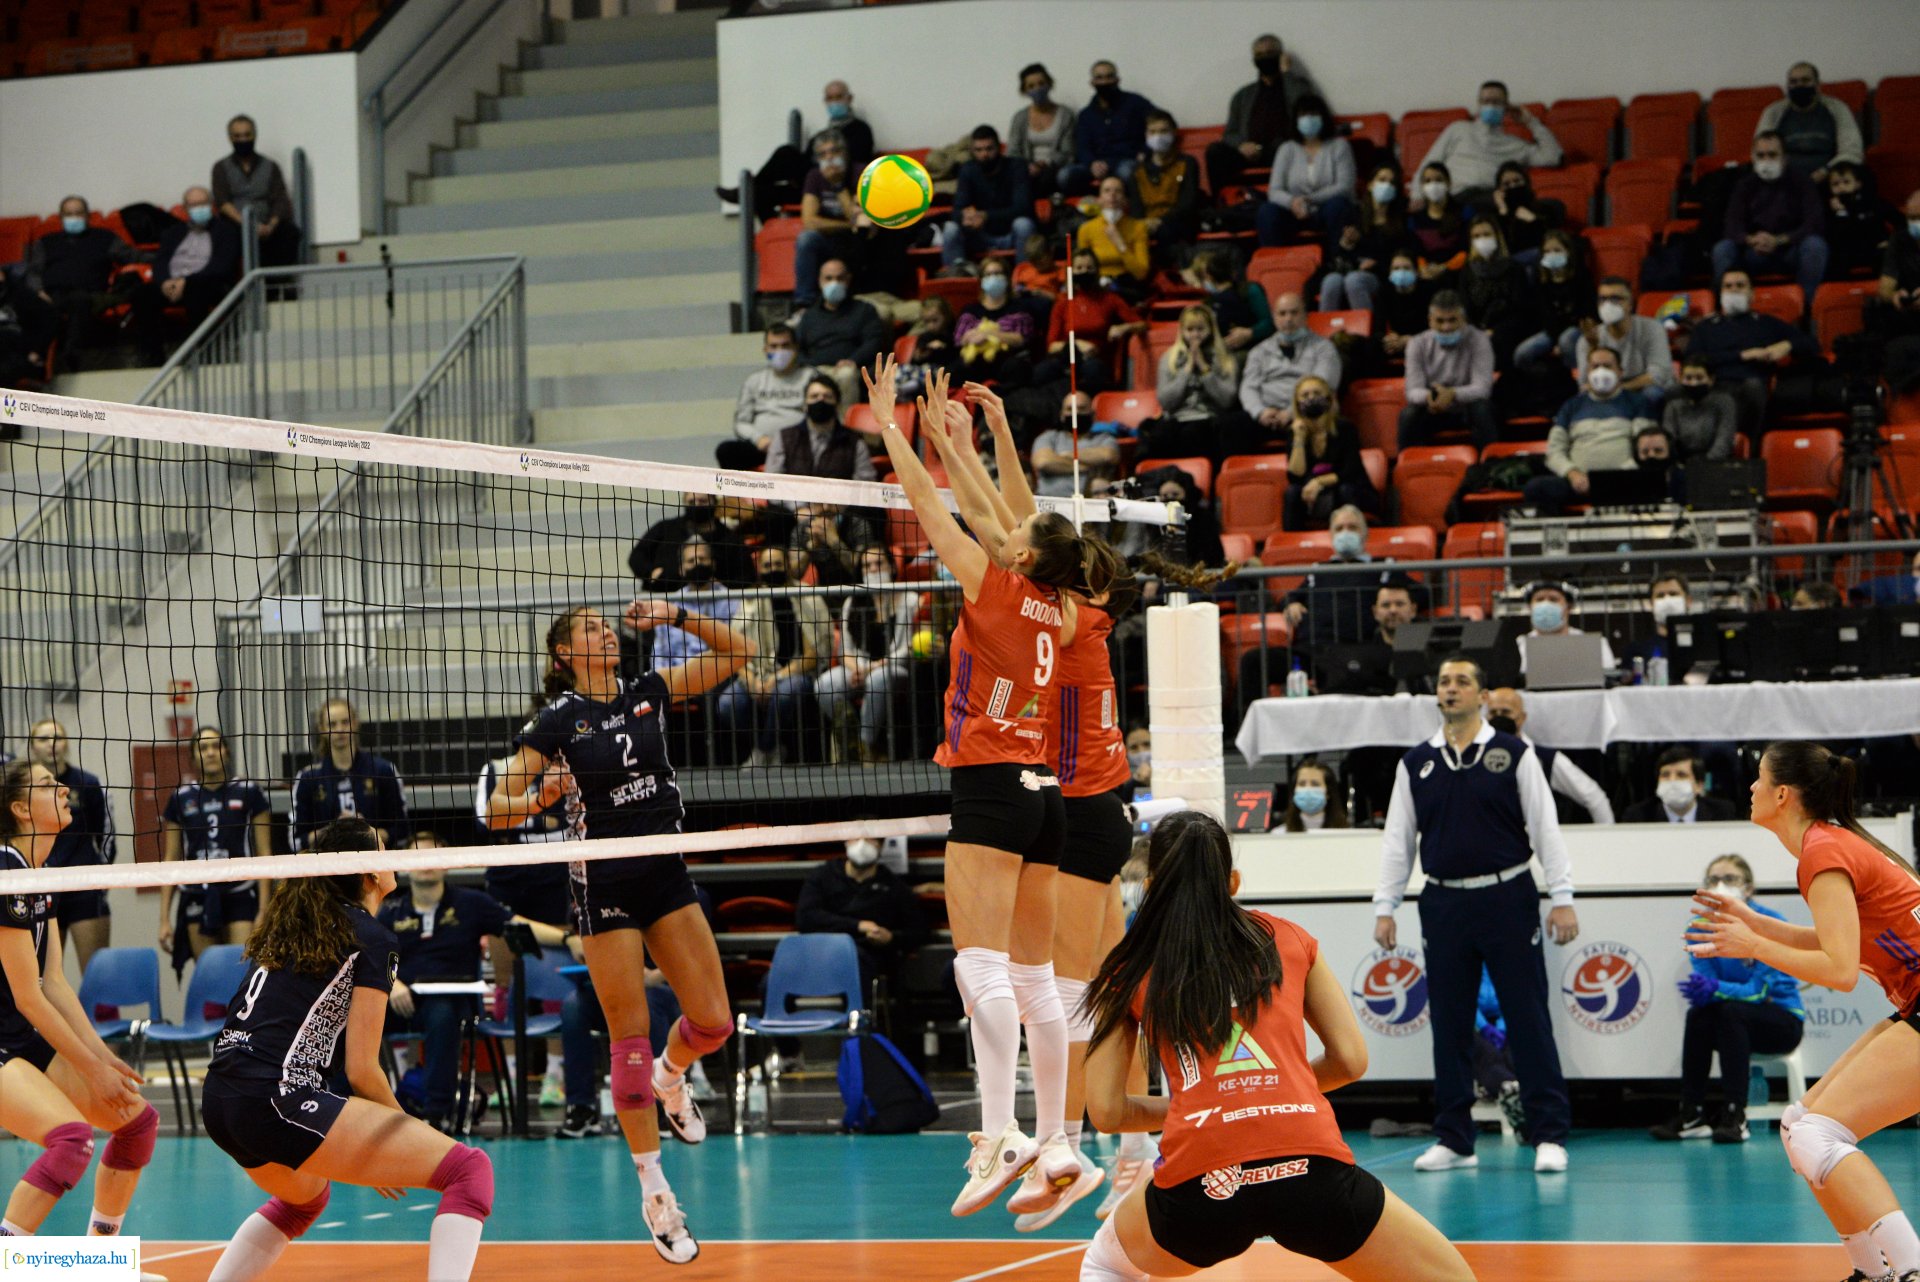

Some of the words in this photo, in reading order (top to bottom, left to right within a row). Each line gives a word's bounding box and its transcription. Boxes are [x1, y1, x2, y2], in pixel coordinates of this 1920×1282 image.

[20, 402, 30, 411] CEV
[32, 403, 60, 416] Champions
[61, 407, 78, 419] League
[80, 409, 94, 421] Volley
[94, 411, 106, 420] 2022
[309, 435, 331, 446] Champions
[333, 438, 347, 448] League
[348, 440, 360, 450] Volley
[1034, 631, 1054, 686] 9
[992, 681, 1008, 716] STRABAG
[615, 733, 638, 767] 2
[207, 813, 219, 838] 3
[1583, 944, 1629, 957] FATUM
[236, 966, 269, 1021] 9
[1264, 1074, 1279, 1085] 21
[1222, 1103, 1316, 1123] BESTRONG
[1241, 1159, 1308, 1185] REVESZ
